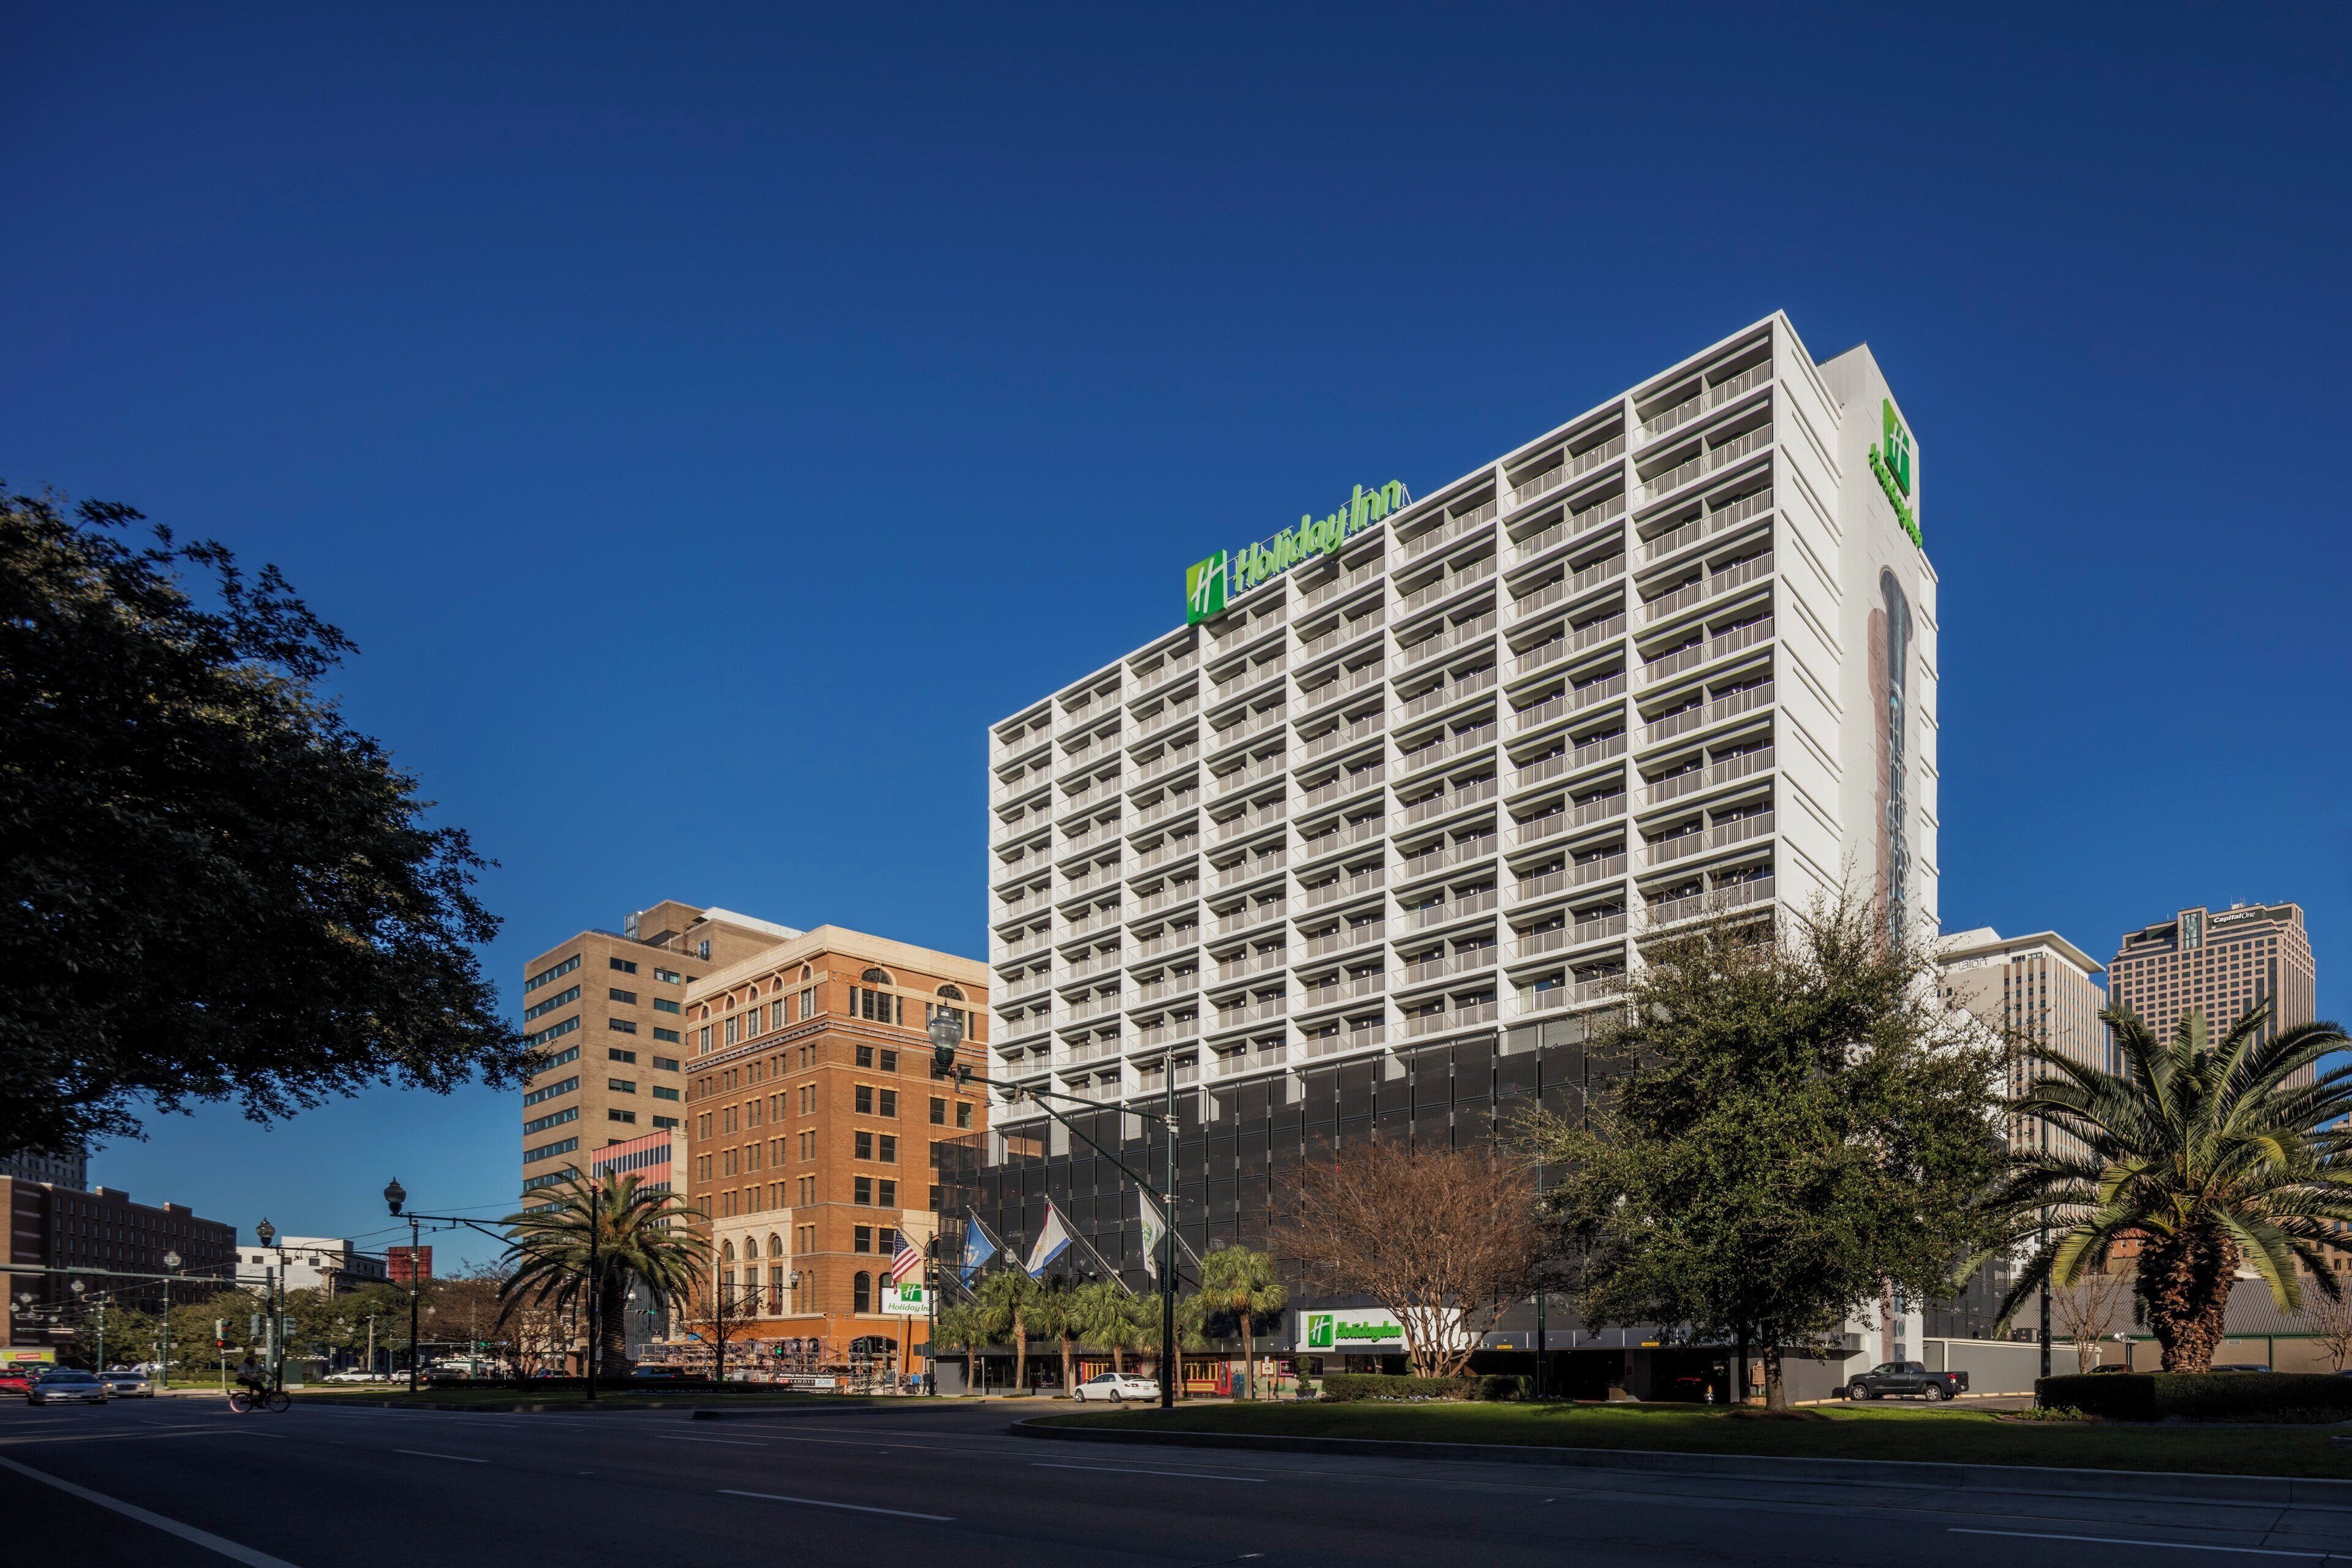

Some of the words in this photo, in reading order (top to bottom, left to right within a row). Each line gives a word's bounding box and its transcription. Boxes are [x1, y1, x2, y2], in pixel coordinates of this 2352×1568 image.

[1234, 508, 1348, 593] Holiday
[1349, 479, 1403, 532] Inn
[888, 1303, 920, 1313] Holiday
